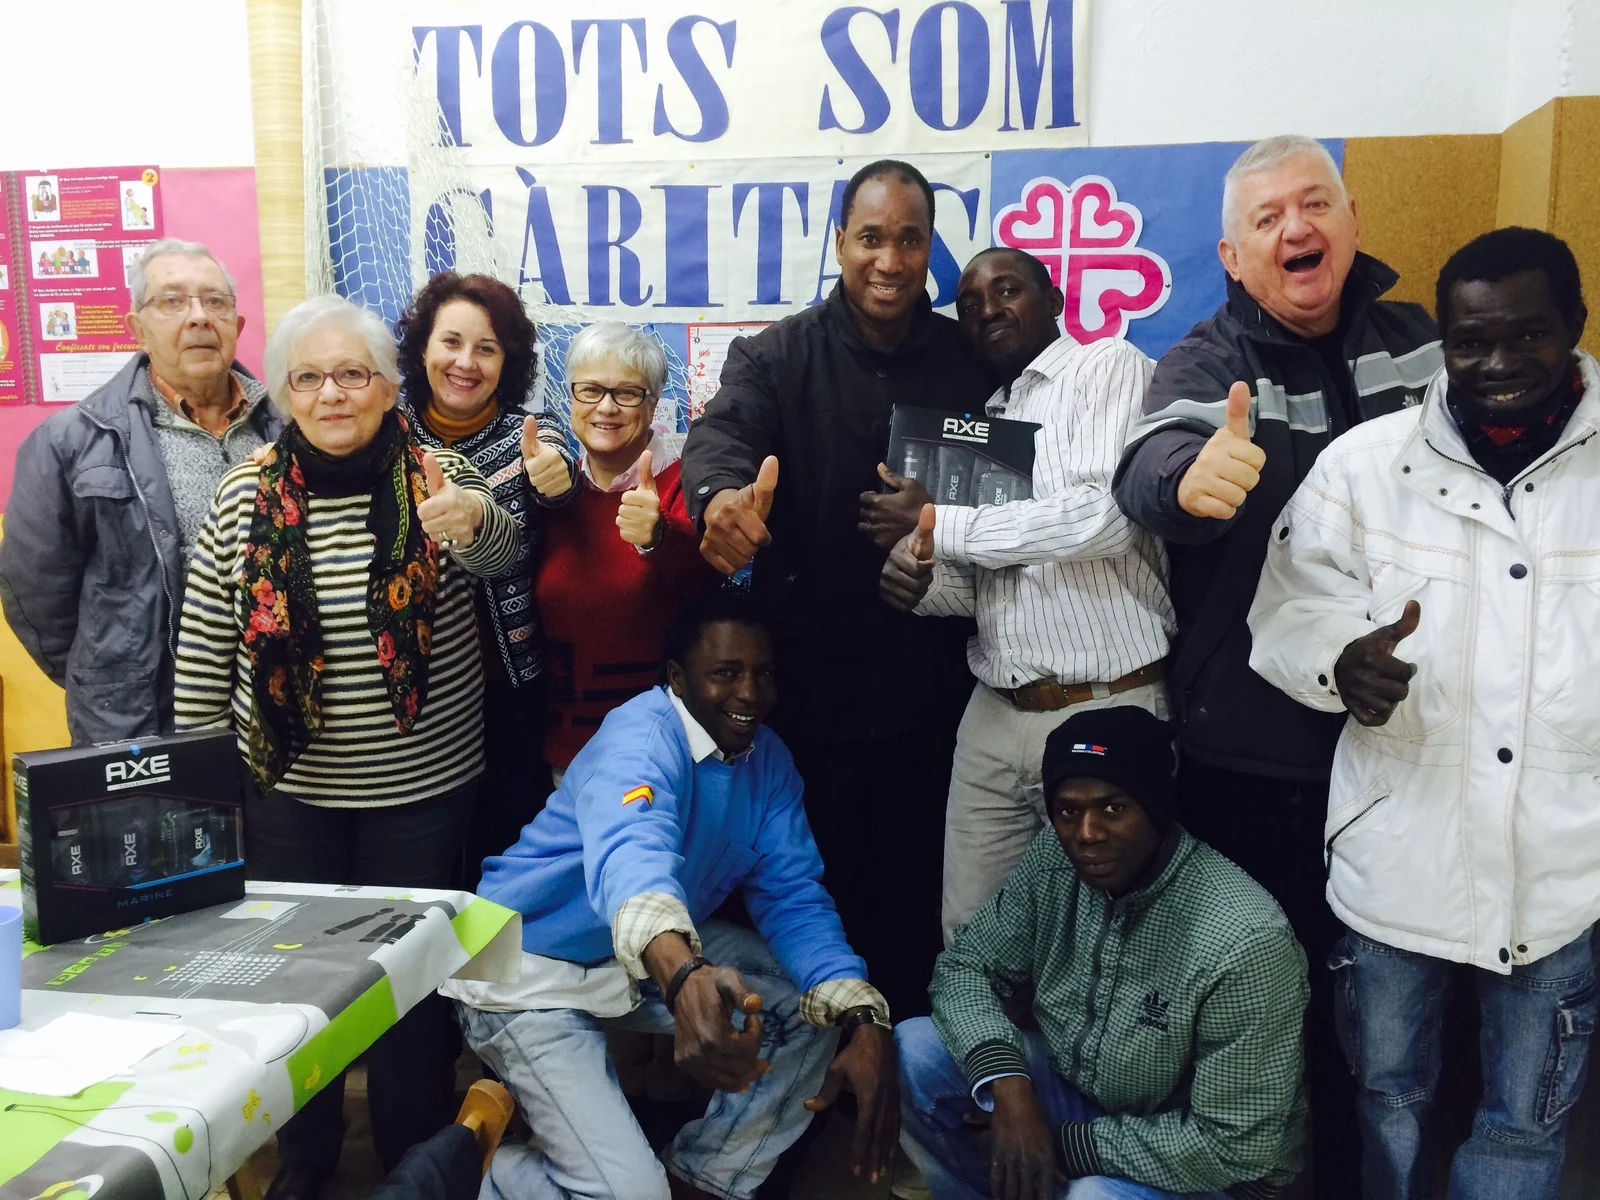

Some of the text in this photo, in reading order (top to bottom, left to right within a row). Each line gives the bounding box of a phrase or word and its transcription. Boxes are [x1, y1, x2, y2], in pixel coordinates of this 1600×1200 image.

[412, 0, 1082, 148] TOTS SOM
[145, 172, 155, 183] 2
[943, 418, 990, 438] AXE
[949, 474, 959, 501] AXE
[105, 753, 171, 783] AXE
[123, 832, 137, 867] AXE
[194, 827, 203, 850] AXE
[71, 844, 82, 876] AXE
[117, 888, 174, 909] MARINE
